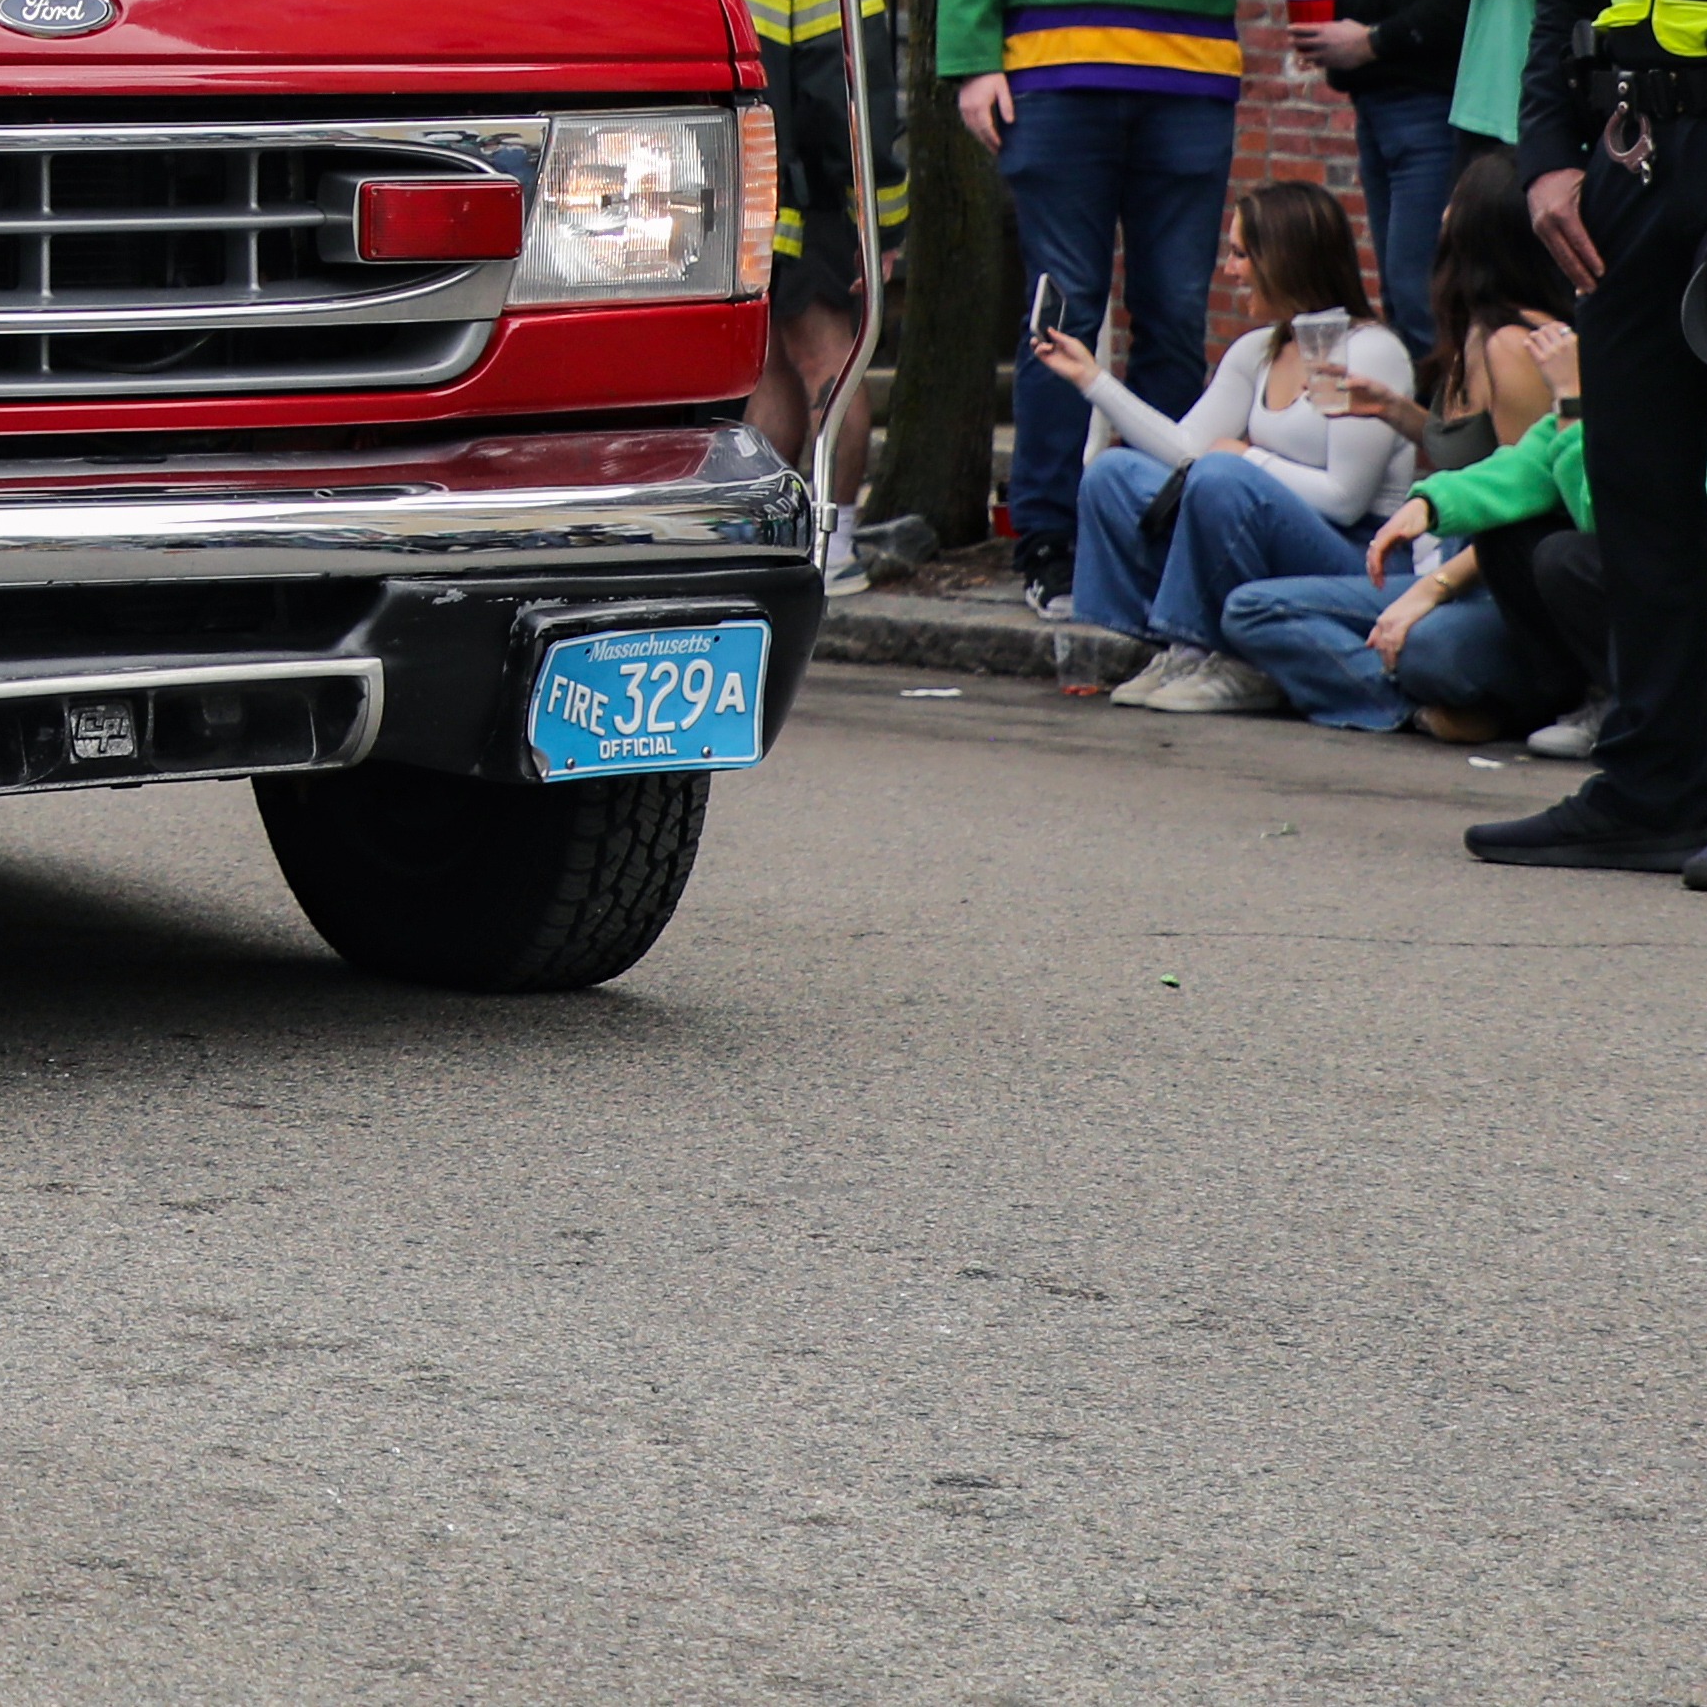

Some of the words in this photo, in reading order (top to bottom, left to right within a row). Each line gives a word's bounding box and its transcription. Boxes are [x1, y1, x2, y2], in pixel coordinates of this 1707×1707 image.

[587, 632, 712, 664] Massachusetts
[547, 673, 609, 737] FIRE
[613, 658, 715, 736] 329
[714, 672, 746, 714] A
[599, 736, 677, 760] OFFICIAL
